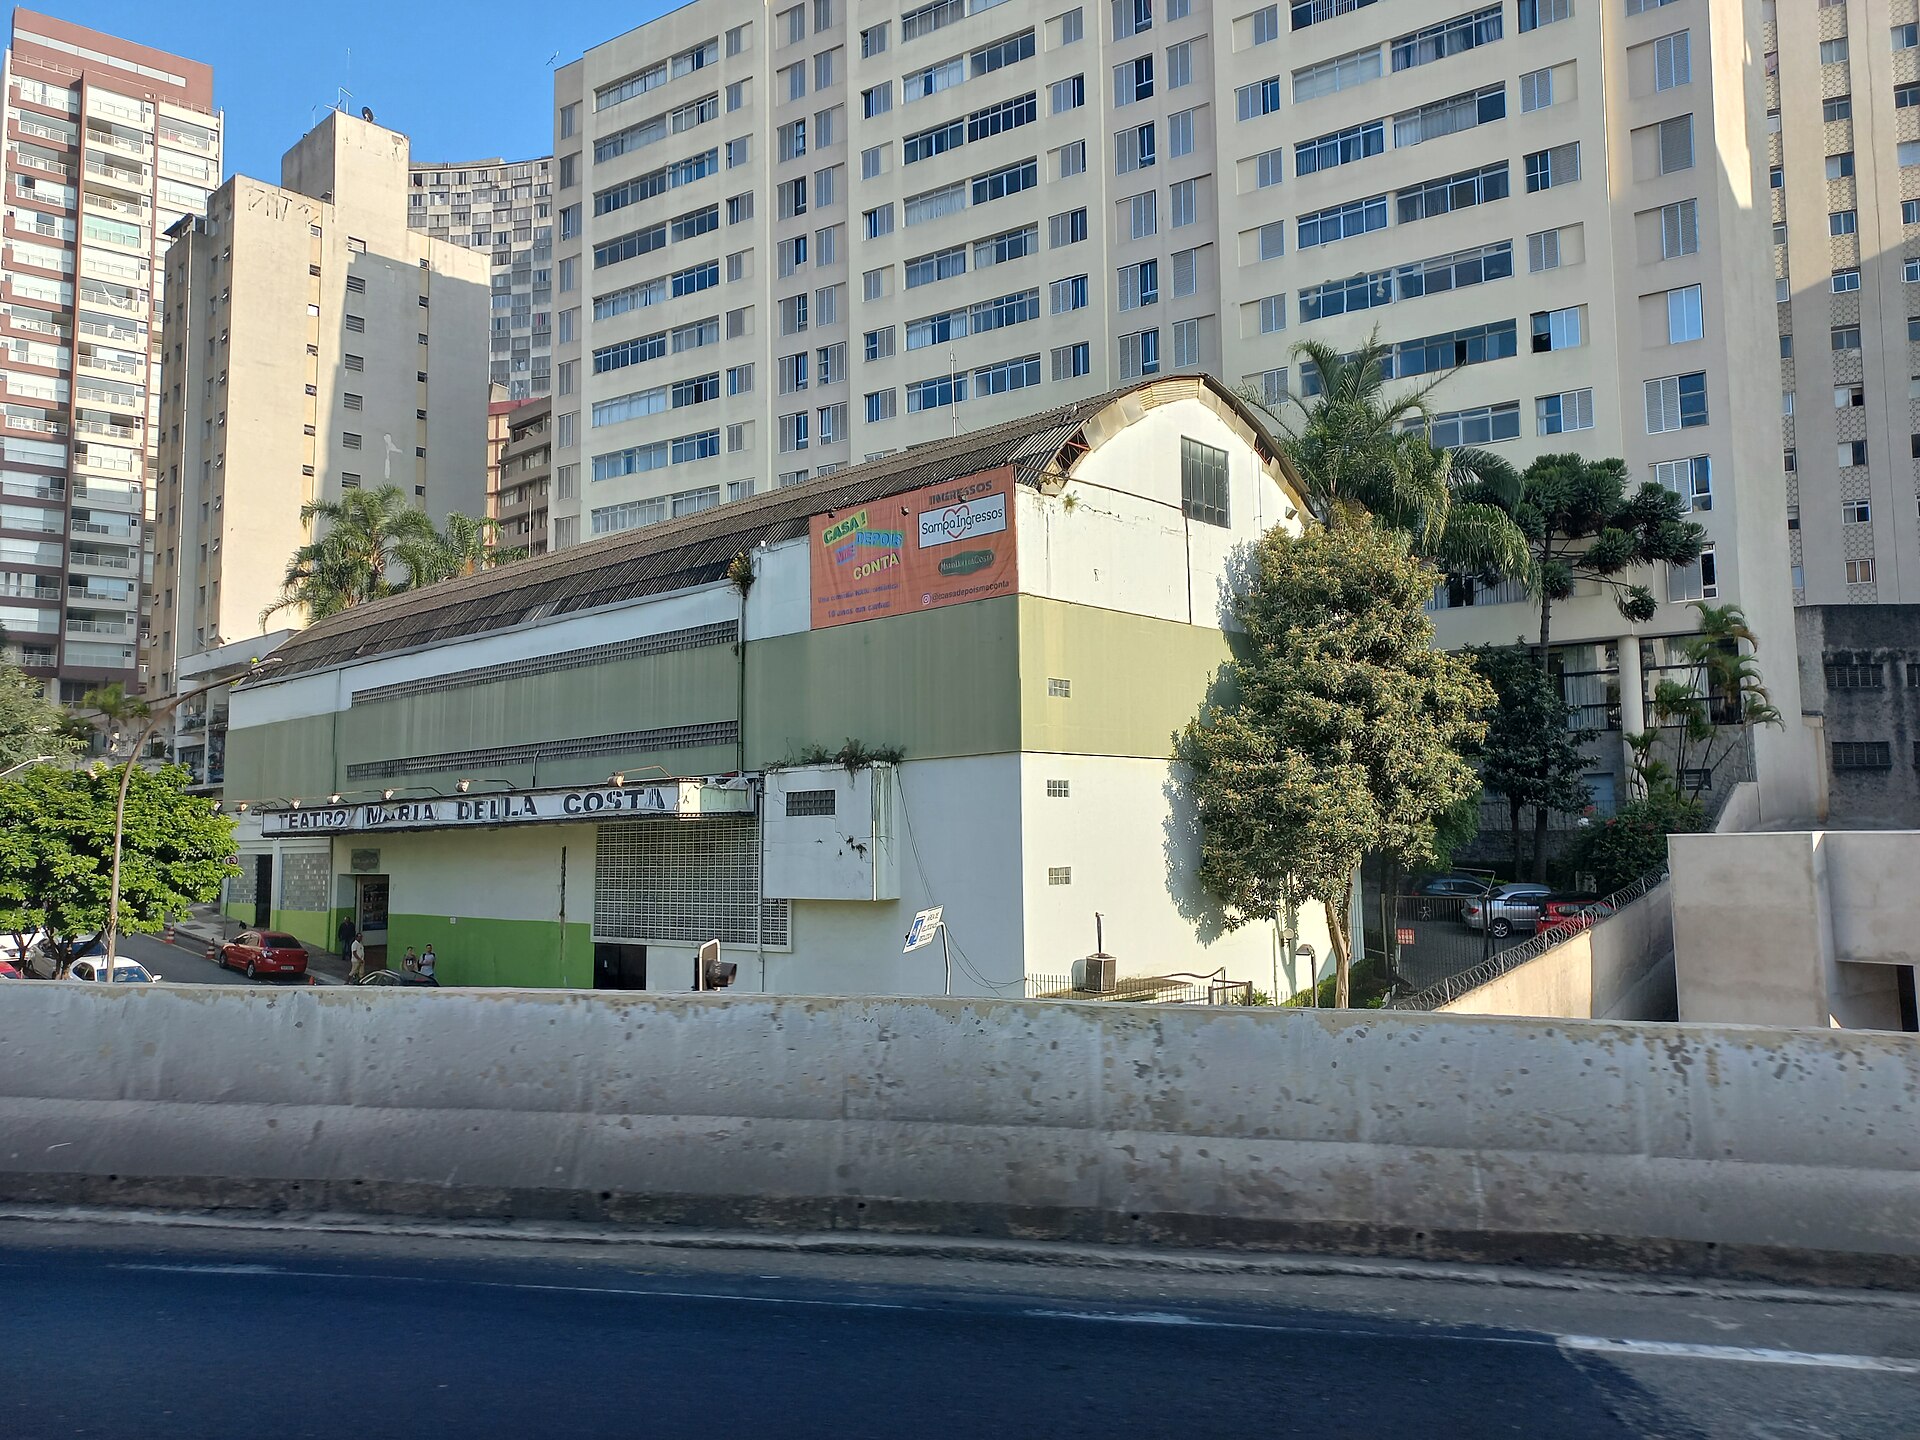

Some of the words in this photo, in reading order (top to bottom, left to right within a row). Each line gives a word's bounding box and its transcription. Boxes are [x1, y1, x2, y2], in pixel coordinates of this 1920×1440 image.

[929, 480, 993, 505] INGRESSOS
[856, 530, 903, 549] DEPOIS
[853, 552, 900, 580] CONTA
[278, 810, 346, 829] TEATRO
[457, 795, 538, 820] DELLA
[563, 788, 666, 814] COSTA
